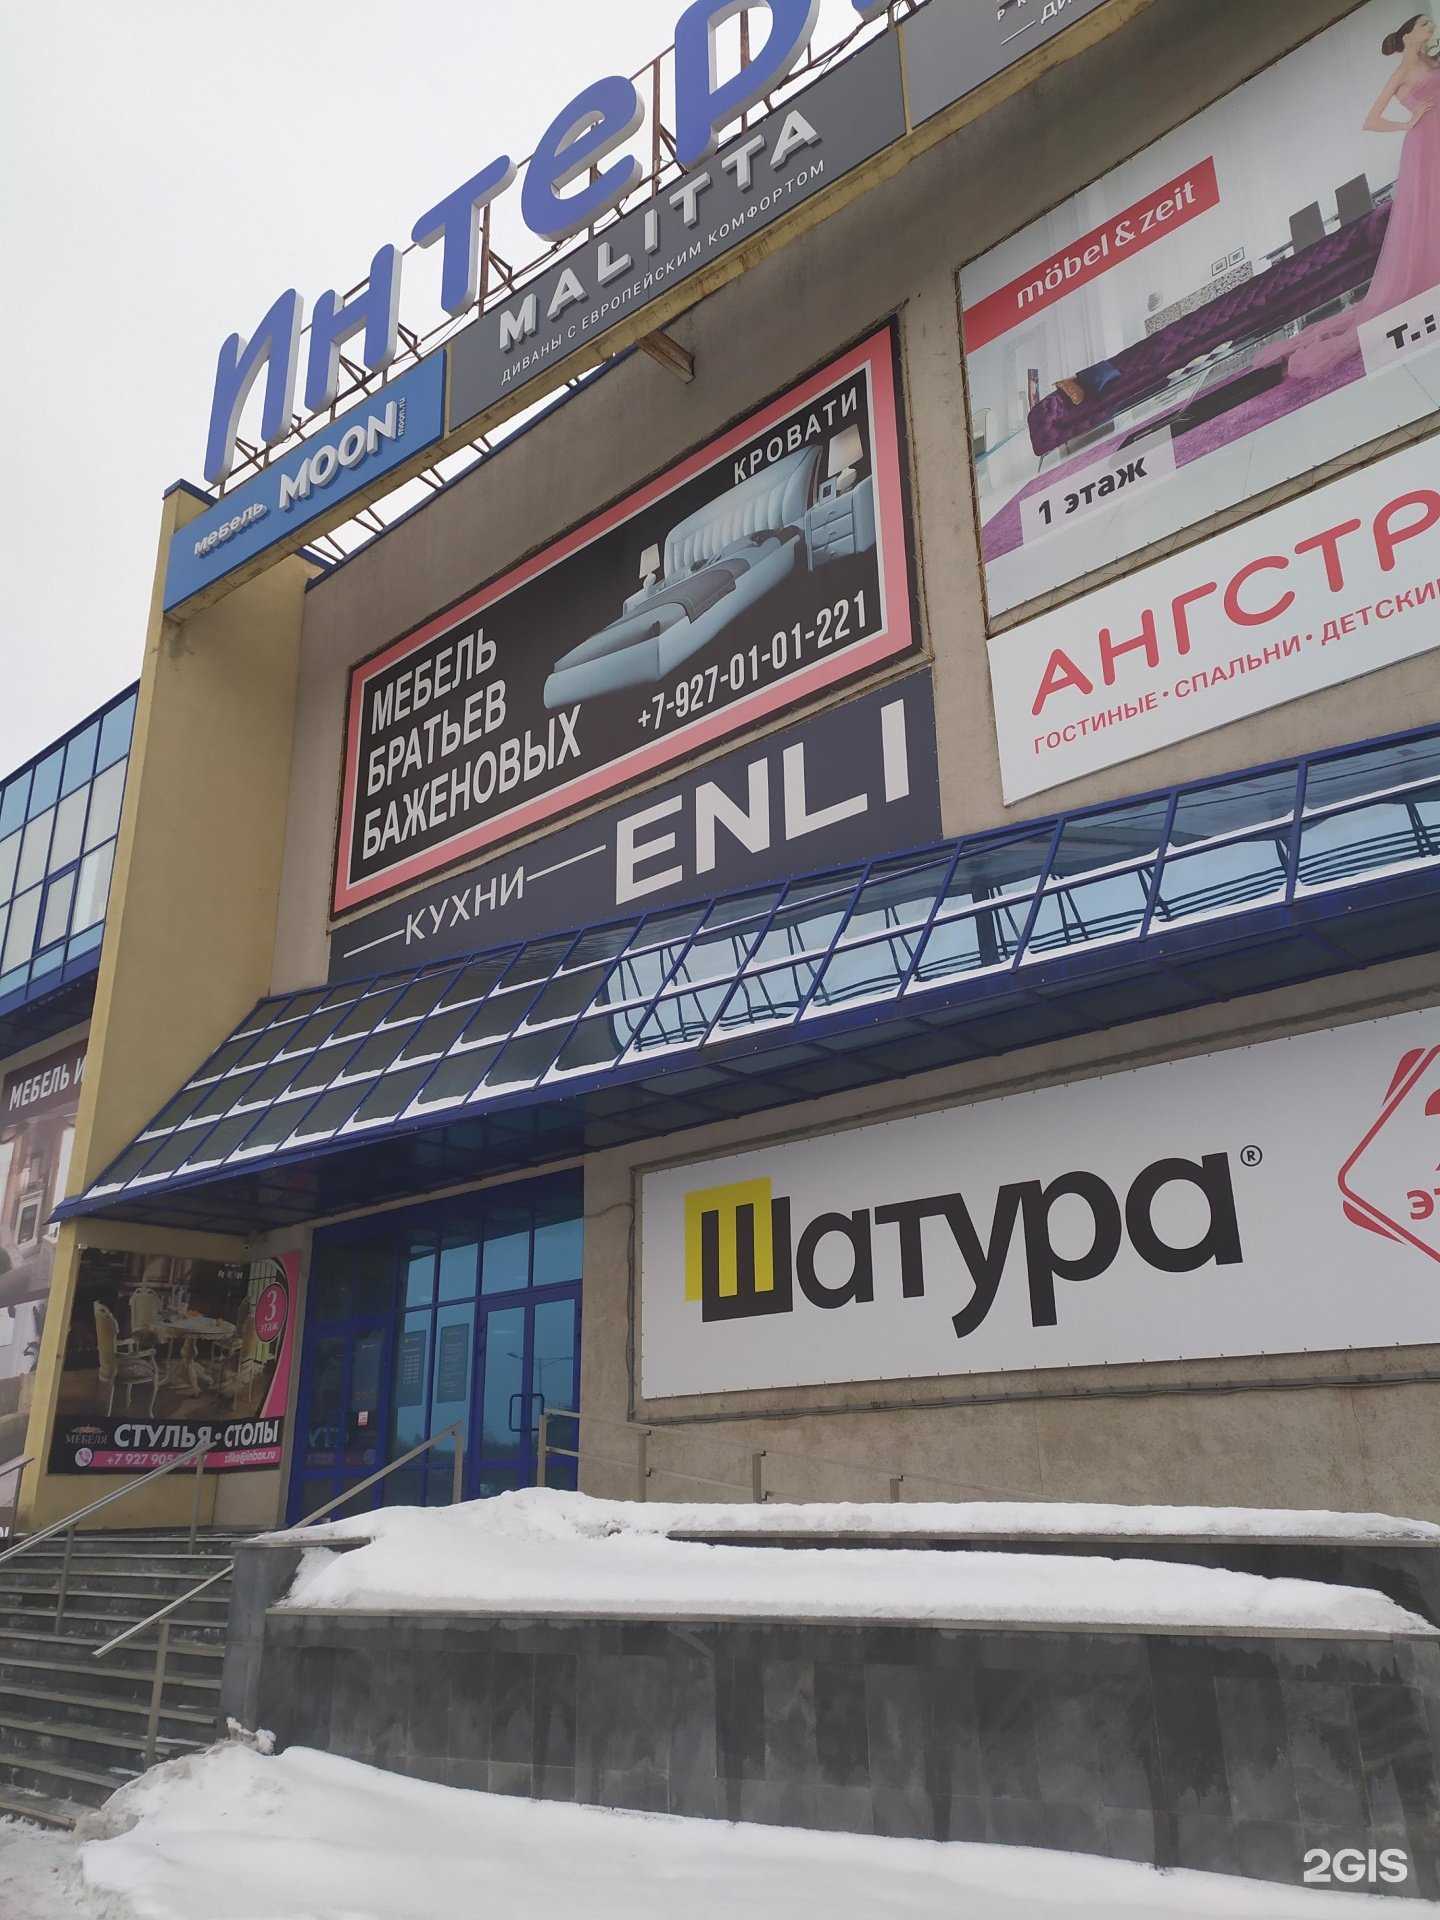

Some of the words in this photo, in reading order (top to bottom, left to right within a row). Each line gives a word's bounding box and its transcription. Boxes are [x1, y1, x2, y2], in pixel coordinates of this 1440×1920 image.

[500, 110, 822, 352] MALITTA
[501, 333, 562, 386] ДИВАНЫ
[567, 325, 577, 338] С
[581, 241, 702, 331] ЕВРОПЕЙСКИМ
[707, 159, 825, 247] КОМФОРТОМ
[1017, 232, 1109, 308] möbel
[1115, 220, 1136, 247] &
[1139, 181, 1197, 233] zeit
[279, 401, 399, 511] MOON
[734, 387, 857, 485] КРОВАТИ
[1038, 500, 1052, 525] 1
[1064, 457, 1148, 514] этаж
[372, 628, 497, 735] МЕБЕЛЬ
[638, 590, 866, 731] +7-927-01-01-221
[1034, 691, 1157, 754] ГОСТИНЫЕ
[1174, 634, 1302, 698] СПАЛЬНИ
[363, 704, 581, 861] БАЖЕНОВЫХ
[367, 680, 506, 796] БРАТЬЕВ
[616, 699, 910, 904] ENLI
[405, 866, 525, 946] КУХНИ
[9, 1063, 70, 1112] МЕБЕЛЬ
[701, 1152, 1243, 1339] Шатура
[264, 1290, 277, 1321] 3
[114, 1423, 212, 1449] СТУЛЬЯ
[224, 1420, 279, 1448] СТОЛЫ
